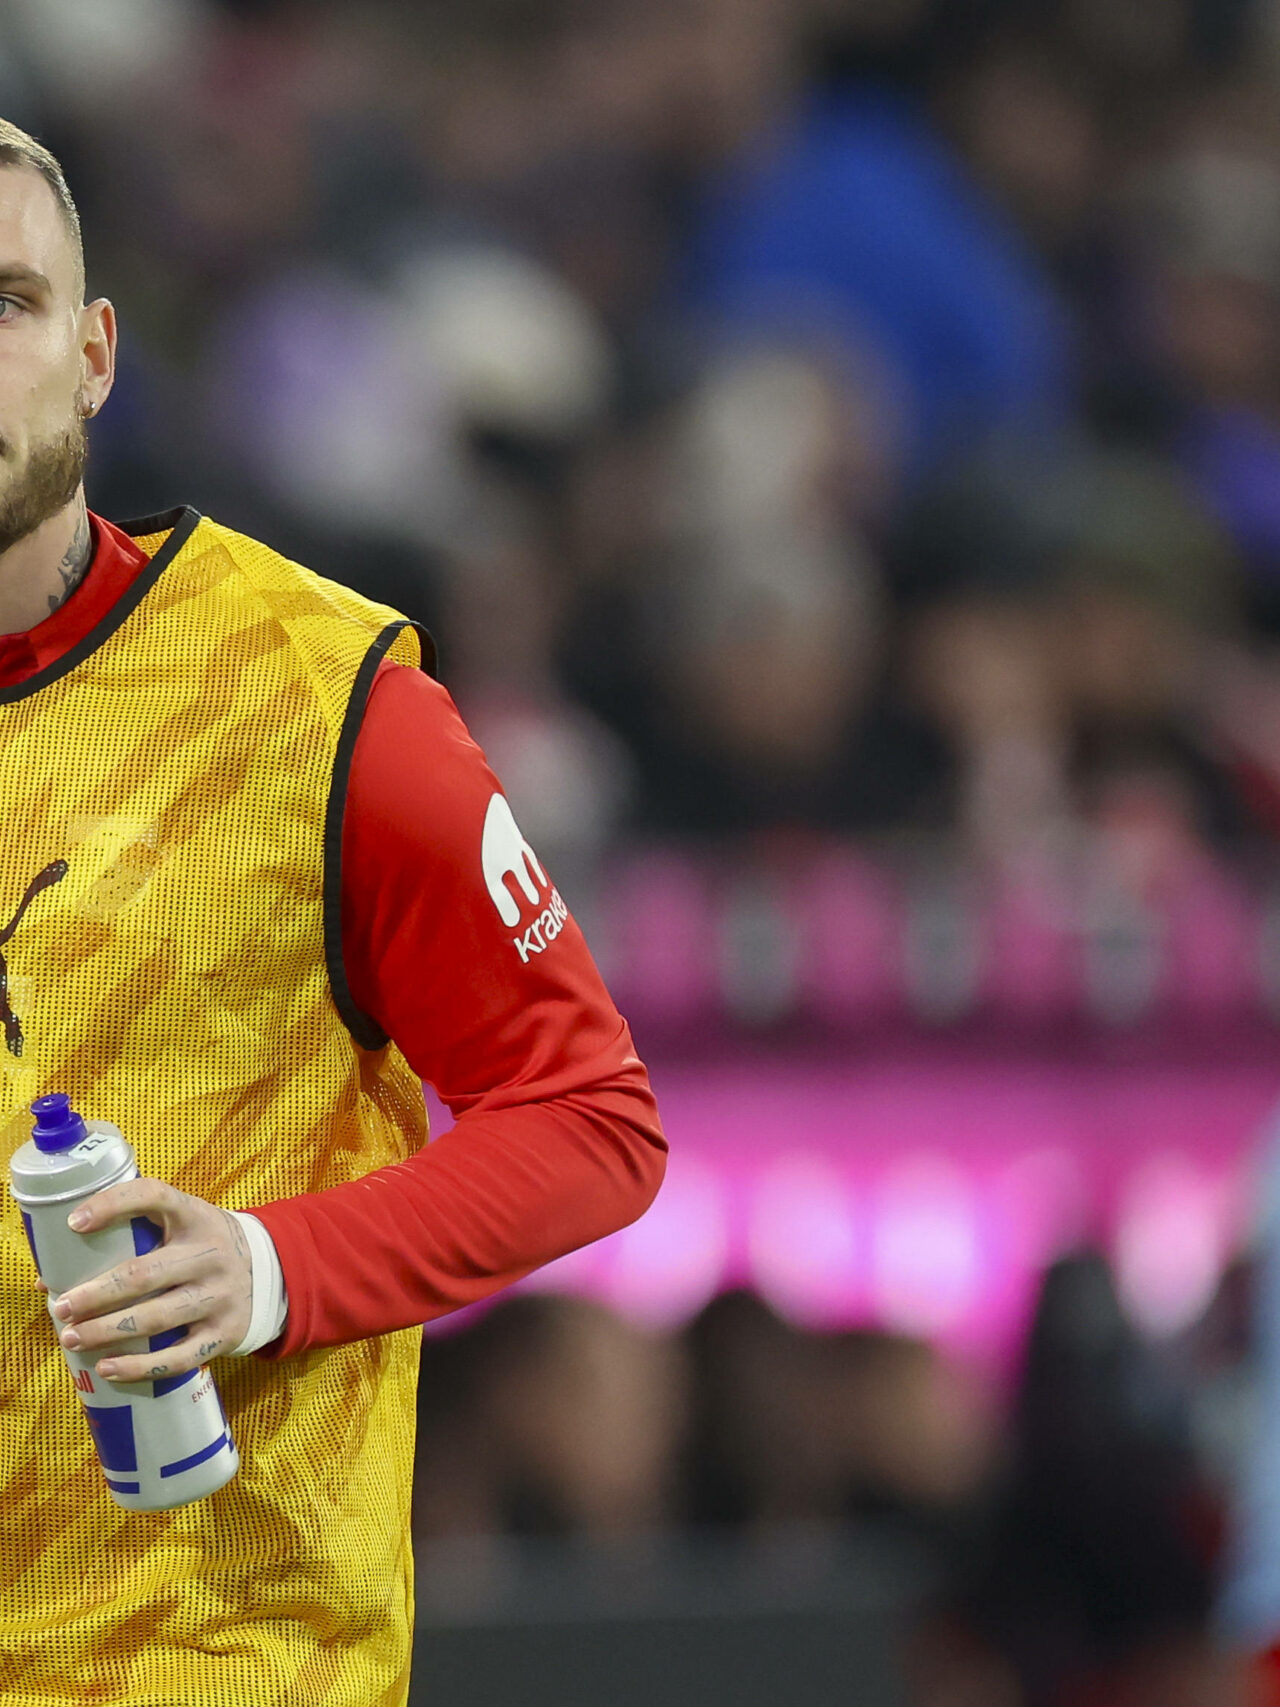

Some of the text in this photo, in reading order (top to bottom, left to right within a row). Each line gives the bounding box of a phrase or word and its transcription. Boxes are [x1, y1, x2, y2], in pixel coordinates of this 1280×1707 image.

[513, 888, 568, 963] krake
[78, 1138, 109, 1151] 22
[73, 1369, 96, 1394] ull
